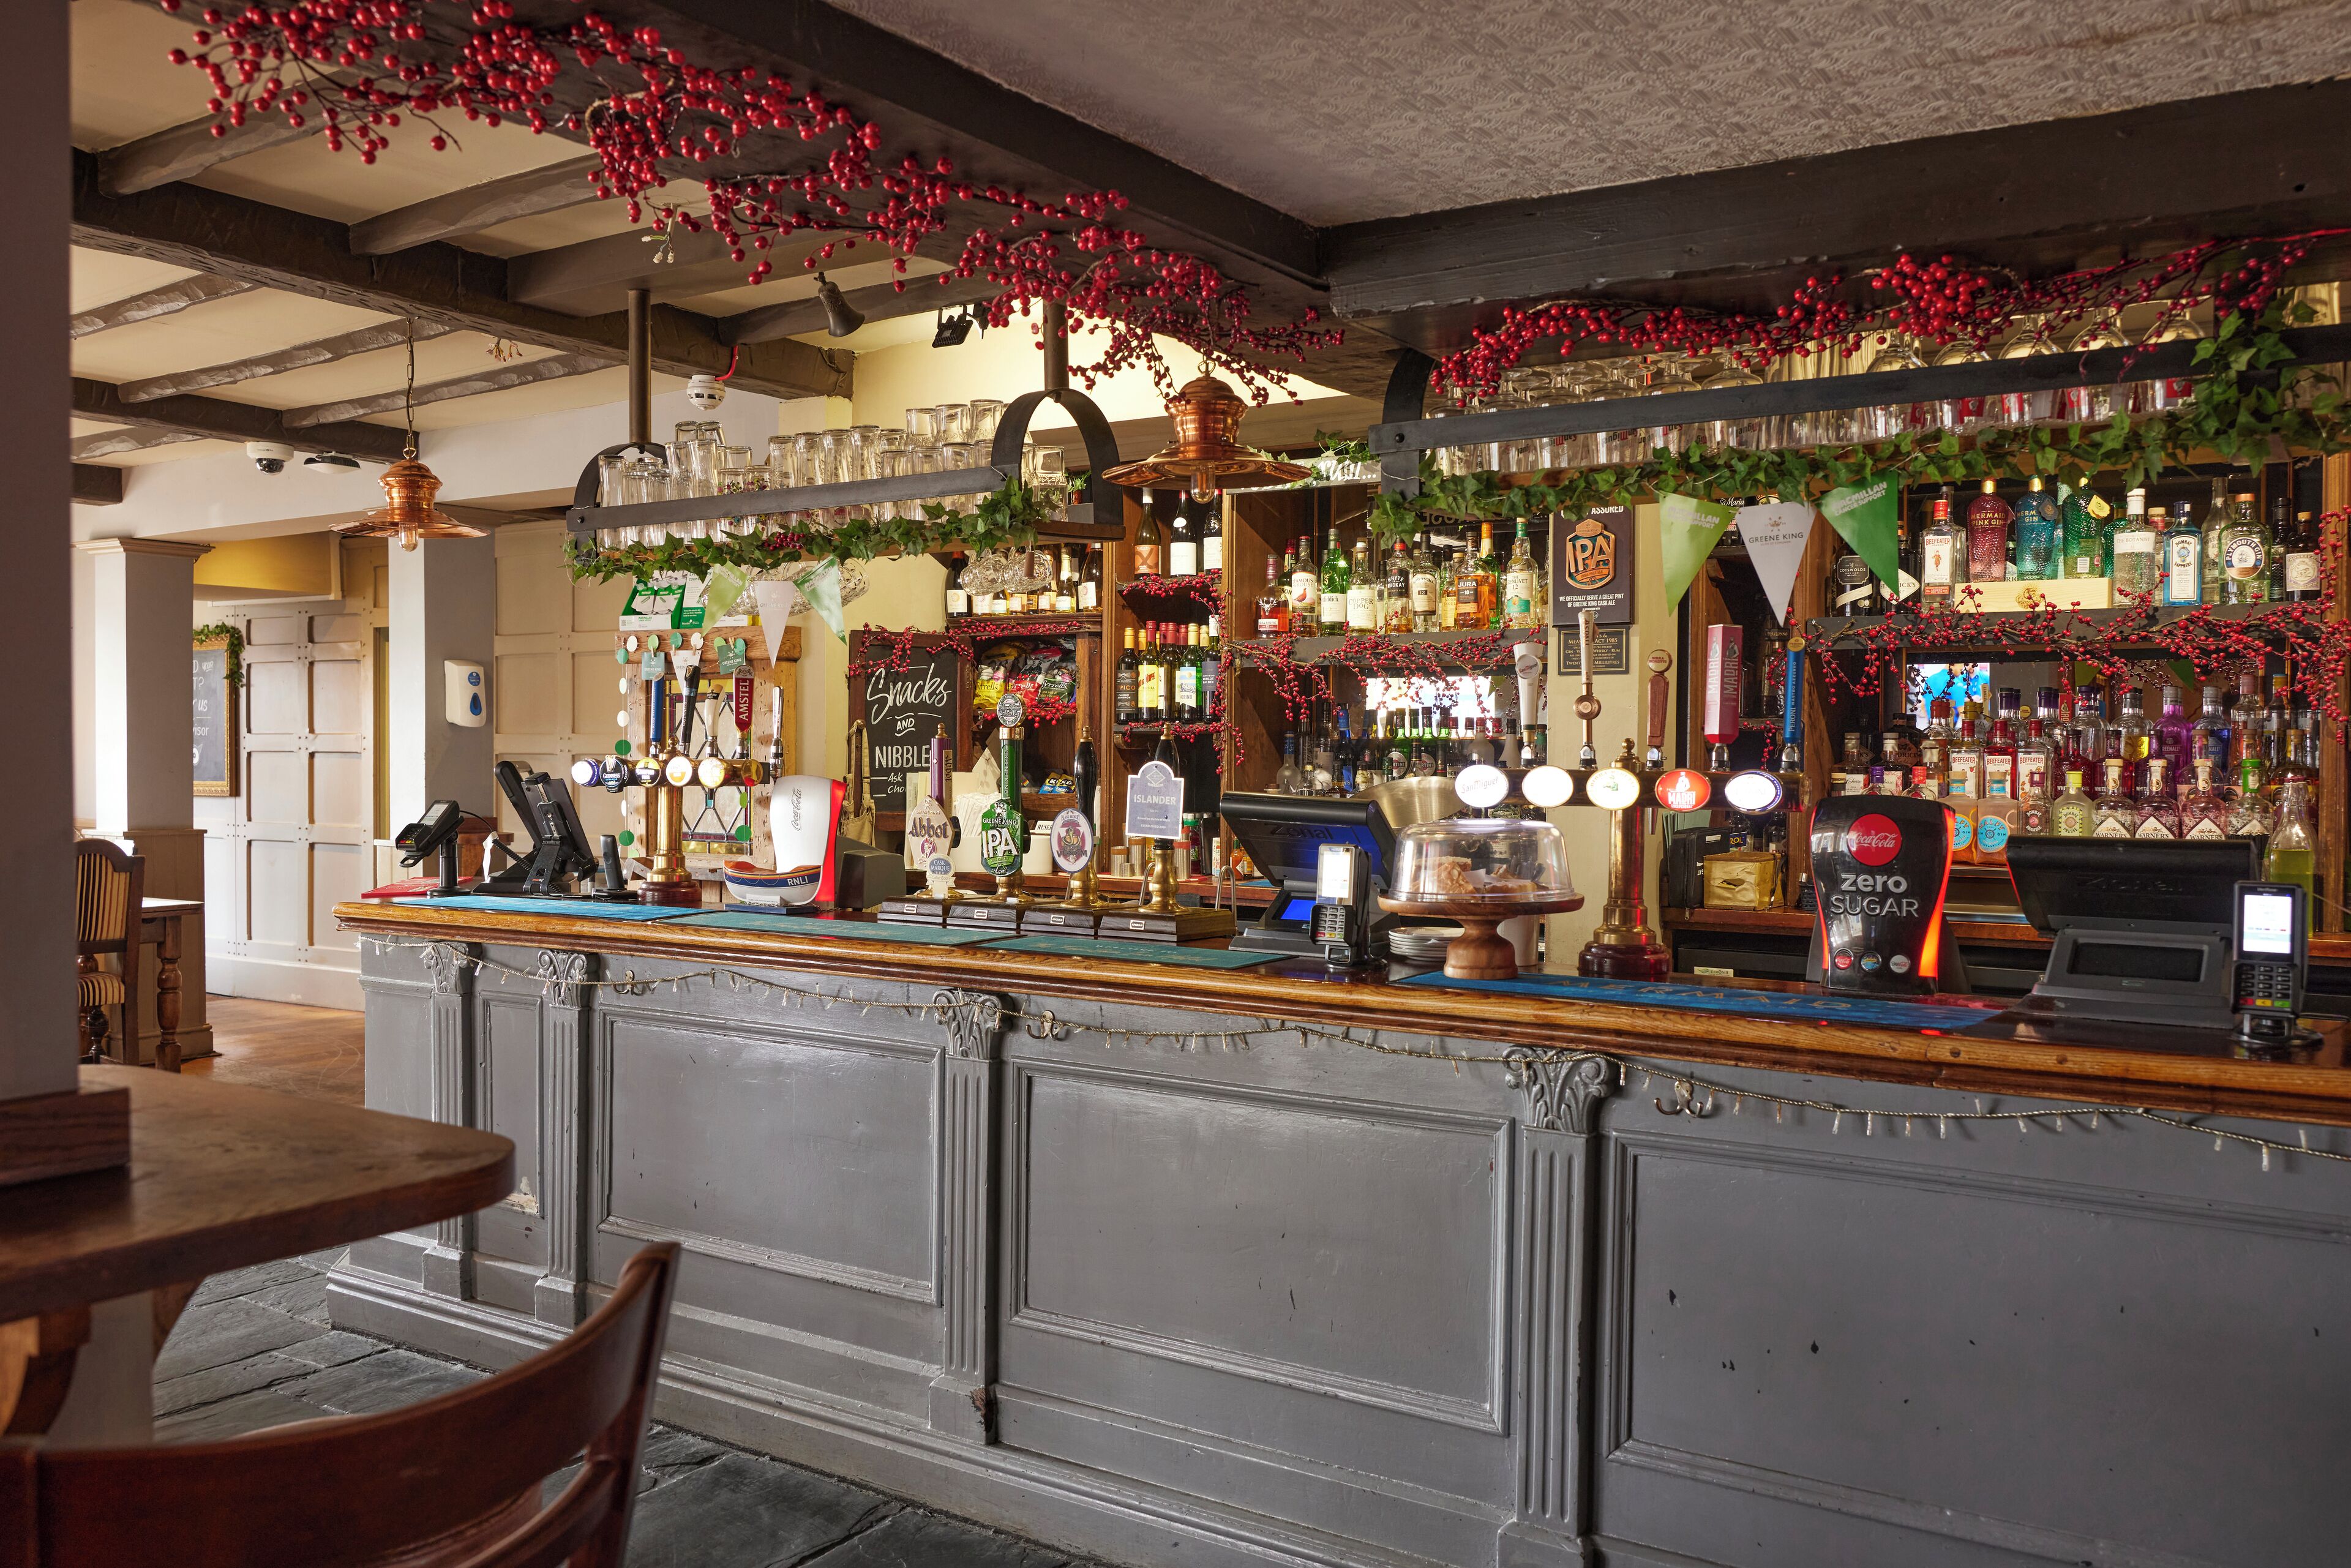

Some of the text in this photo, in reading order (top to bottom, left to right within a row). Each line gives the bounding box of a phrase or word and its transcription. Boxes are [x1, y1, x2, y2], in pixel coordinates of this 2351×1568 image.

[1726, 497, 1744, 506] Maria
[1831, 481, 1887, 509] MACMILLAN
[1859, 490, 1886, 505] SUPPORT
[1591, 506, 1624, 515] ASSURED
[1749, 535, 1780, 544] GREENE
[2225, 539, 2254, 560] PLYMOUTH
[1568, 536, 1611, 573] IPA
[739, 680, 749, 721] AMSTEL
[866, 663, 952, 725] Snacks
[896, 718, 915, 731] AND
[875, 745, 931, 768] NIBBLE
[887, 772, 903, 782] Ask
[1461, 776, 1498, 793] San Miguel
[790, 787, 802, 831] Coca-Cola
[1134, 794, 1176, 805] ISLANDER
[909, 816, 950, 839] Abbot
[1979, 820, 2005, 831] MALFY
[981, 828, 1019, 858] IPA
[1853, 833, 1898, 848] Coca-Cola
[787, 876, 809, 886] RNLI
[1841, 872, 1908, 893] zero
[1831, 895, 1919, 917] SUGAR
[1555, 981, 1851, 1008] MERMAID
